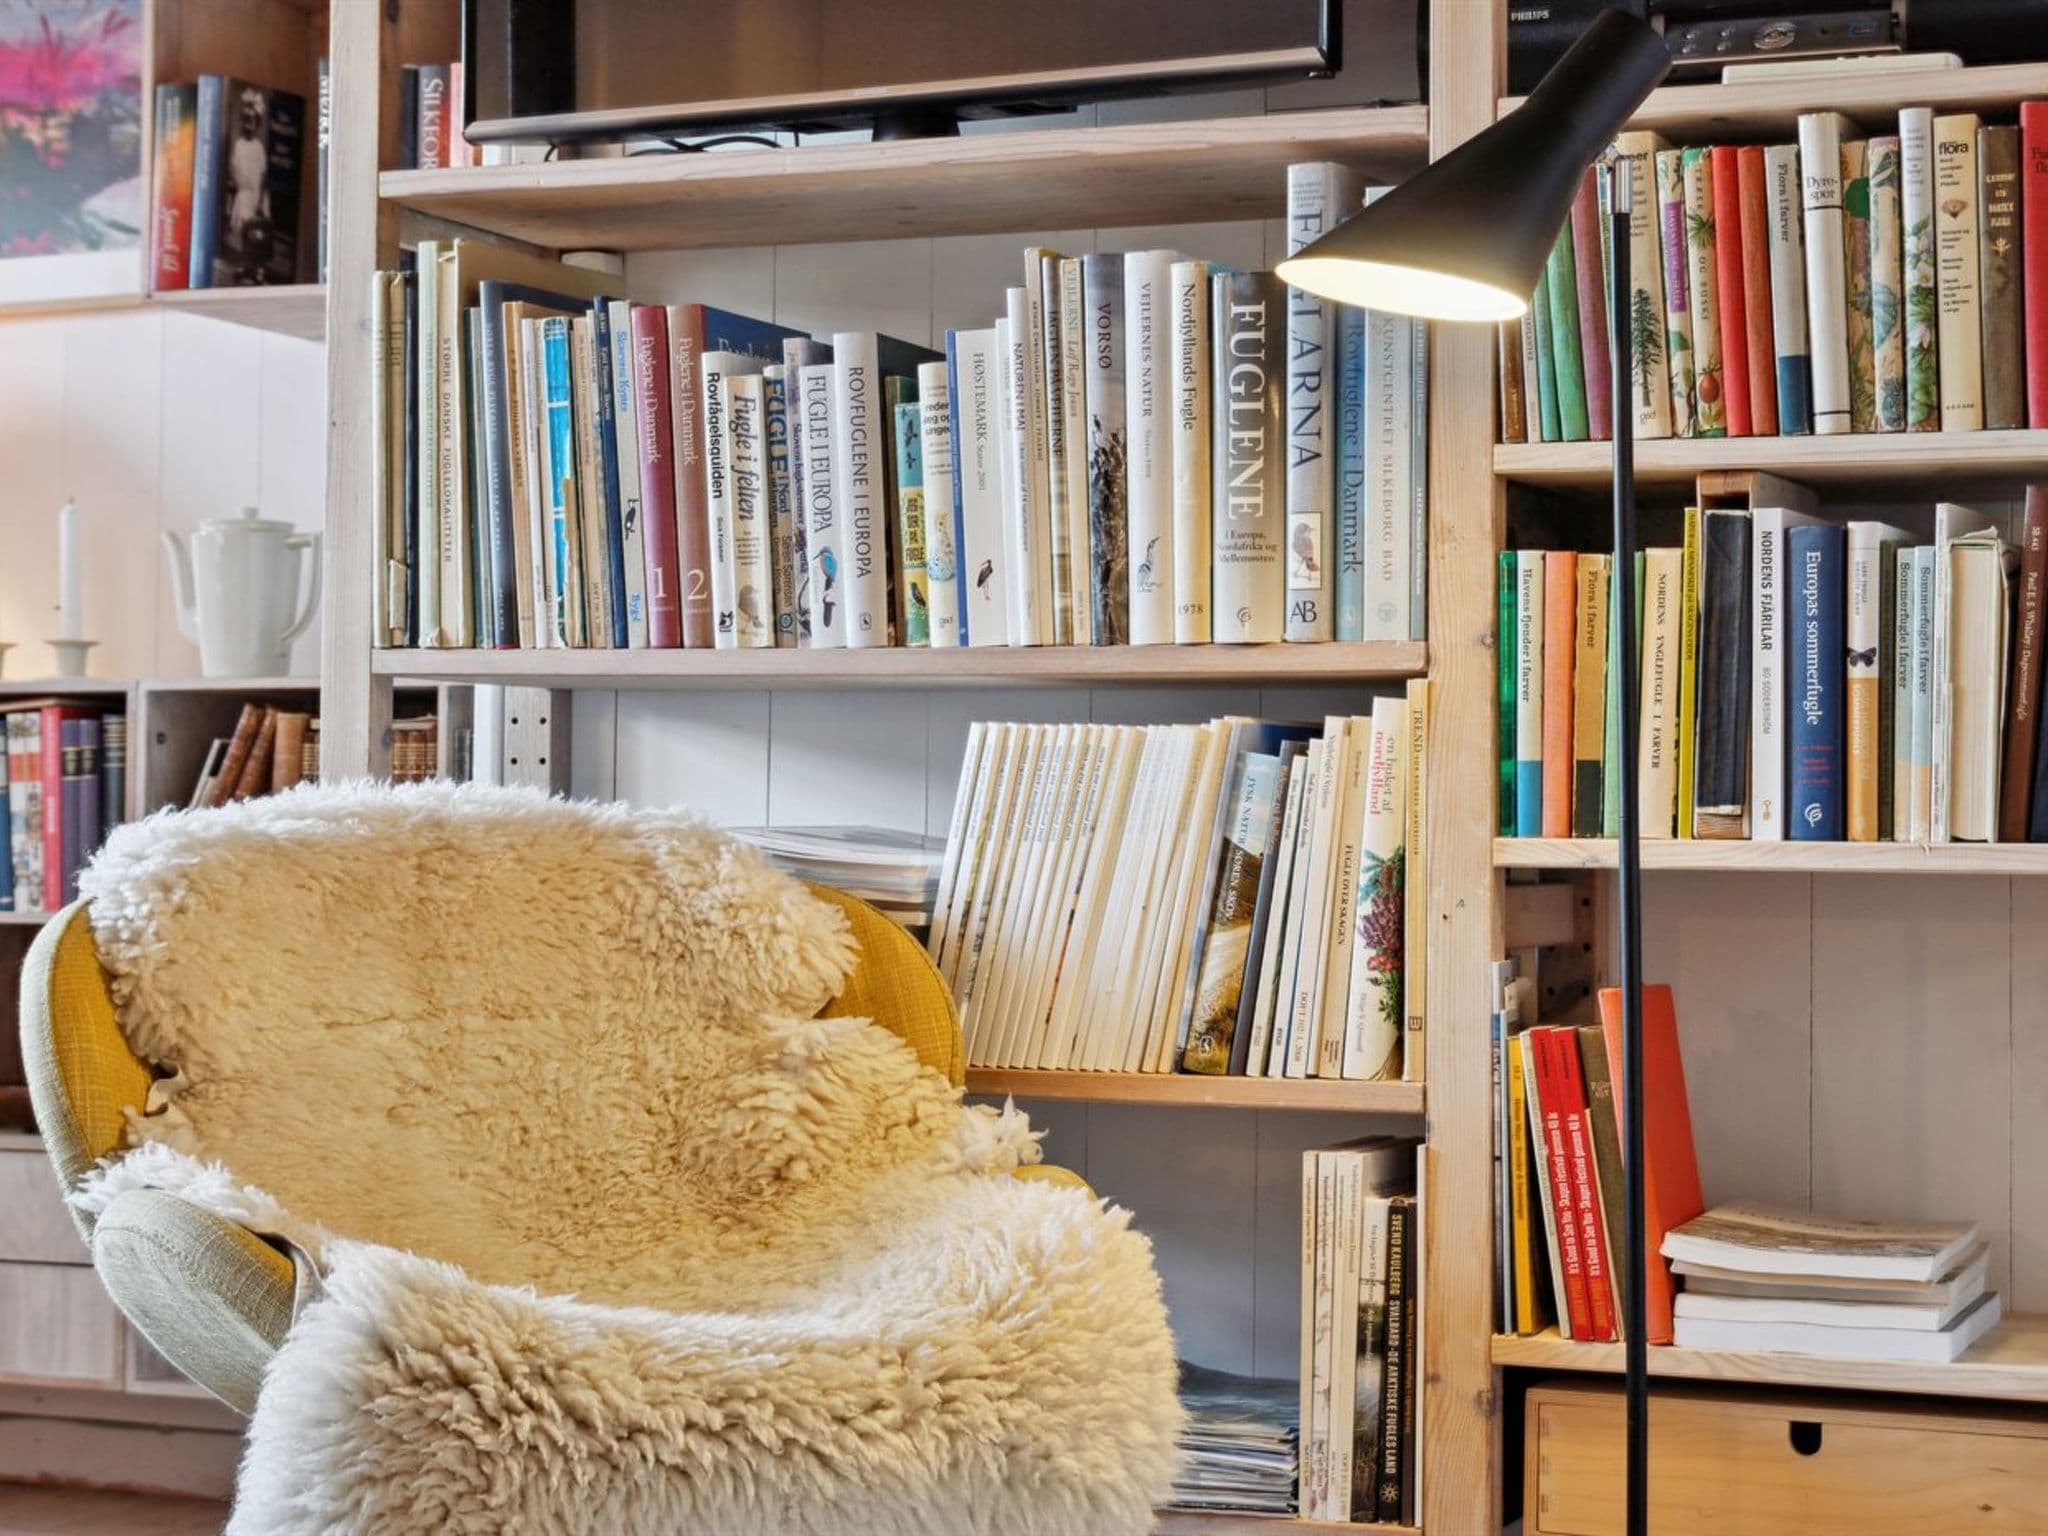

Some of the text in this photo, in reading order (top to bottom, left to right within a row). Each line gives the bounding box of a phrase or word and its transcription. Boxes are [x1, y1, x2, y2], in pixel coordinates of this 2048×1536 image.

[1511, 10, 1549, 21] PHILIPS
[1939, 142, 1969, 155] flora
[1778, 162, 1789, 243] Flora farver
[1698, 256, 1707, 270] OG
[1097, 301, 1112, 370] VORSØ
[1141, 282, 1153, 363] VEJLERNES
[639, 336, 658, 390] Fuglene
[676, 337, 694, 391] Fuglene
[1178, 283, 1198, 431] Nordjyllands Fugle
[973, 352, 988, 442] HØSTEMARK
[1142, 367, 1153, 417] NATUR
[1340, 322, 1366, 446] Rovfuglene
[644, 398, 662, 464] Danmark
[681, 399, 699, 466] Danmark
[848, 366, 870, 487] ROVFUGLENE
[1228, 300, 1266, 521] FUGLENE
[729, 395, 761, 523] Fugle i felten
[765, 379, 789, 474] FUGLE
[777, 483, 791, 514] Nord
[807, 375, 833, 534] FUGLE I EUROPA
[1380, 317, 1395, 581] KUNSTCENTRET SILKEBORG BAD
[855, 507, 872, 579] EUROPA
[1342, 469, 1365, 574] Danmark
[652, 567, 667, 598] 1
[1761, 530, 1774, 590] NORDENS
[687, 569, 708, 601] 2
[1521, 568, 1533, 613] Havens
[1586, 570, 1599, 602] Flora
[1656, 574, 1668, 626] NORDENS
[1898, 561, 1911, 643] Sommerfugle
[1918, 566, 1932, 645] Sommerfugle
[1290, 600, 1318, 624] AB
[1586, 612, 1597, 649] farver
[1761, 593, 1775, 651] FJÄRILAR
[1521, 614, 1533, 657] fjender
[1803, 550, 1824, 725] Europas sommerfugle
[1521, 666, 1531, 703] farver
[1653, 635, 1665, 706] YNGLEFUGLE
[1898, 652, 1910, 689] farver
[1919, 656, 1930, 695] farver
[1412, 708, 1424, 753] TREND
[1651, 727, 1662, 769] FARVER
[1244, 776, 1258, 804] JYSK
[1369, 731, 1387, 816] nordjylland
[1382, 757, 1398, 796] buket
[1229, 849, 1244, 887] SØREN
[1342, 844, 1354, 876] FUGLE
[1553, 1156, 1567, 1182] Festival
[1574, 1158, 1589, 1184] Festival
[1557, 1182, 1571, 1207] Skagen
[1561, 1211, 1573, 1223] You
[1578, 1184, 1592, 1209] Skagen
[1390, 1213, 1403, 1245] SVEND
[1563, 1224, 1574, 1237] See
[1582, 1212, 1594, 1225] You
[1583, 1225, 1595, 1239] See
[1565, 1245, 1578, 1263] Good
[1586, 1246, 1599, 1265] Good
[1388, 1299, 1401, 1347] SVALBARD
[1386, 1364, 1400, 1411] ARKTISKE
[1385, 1412, 1399, 1448] FUGLES
[1384, 1449, 1397, 1475] LAND
